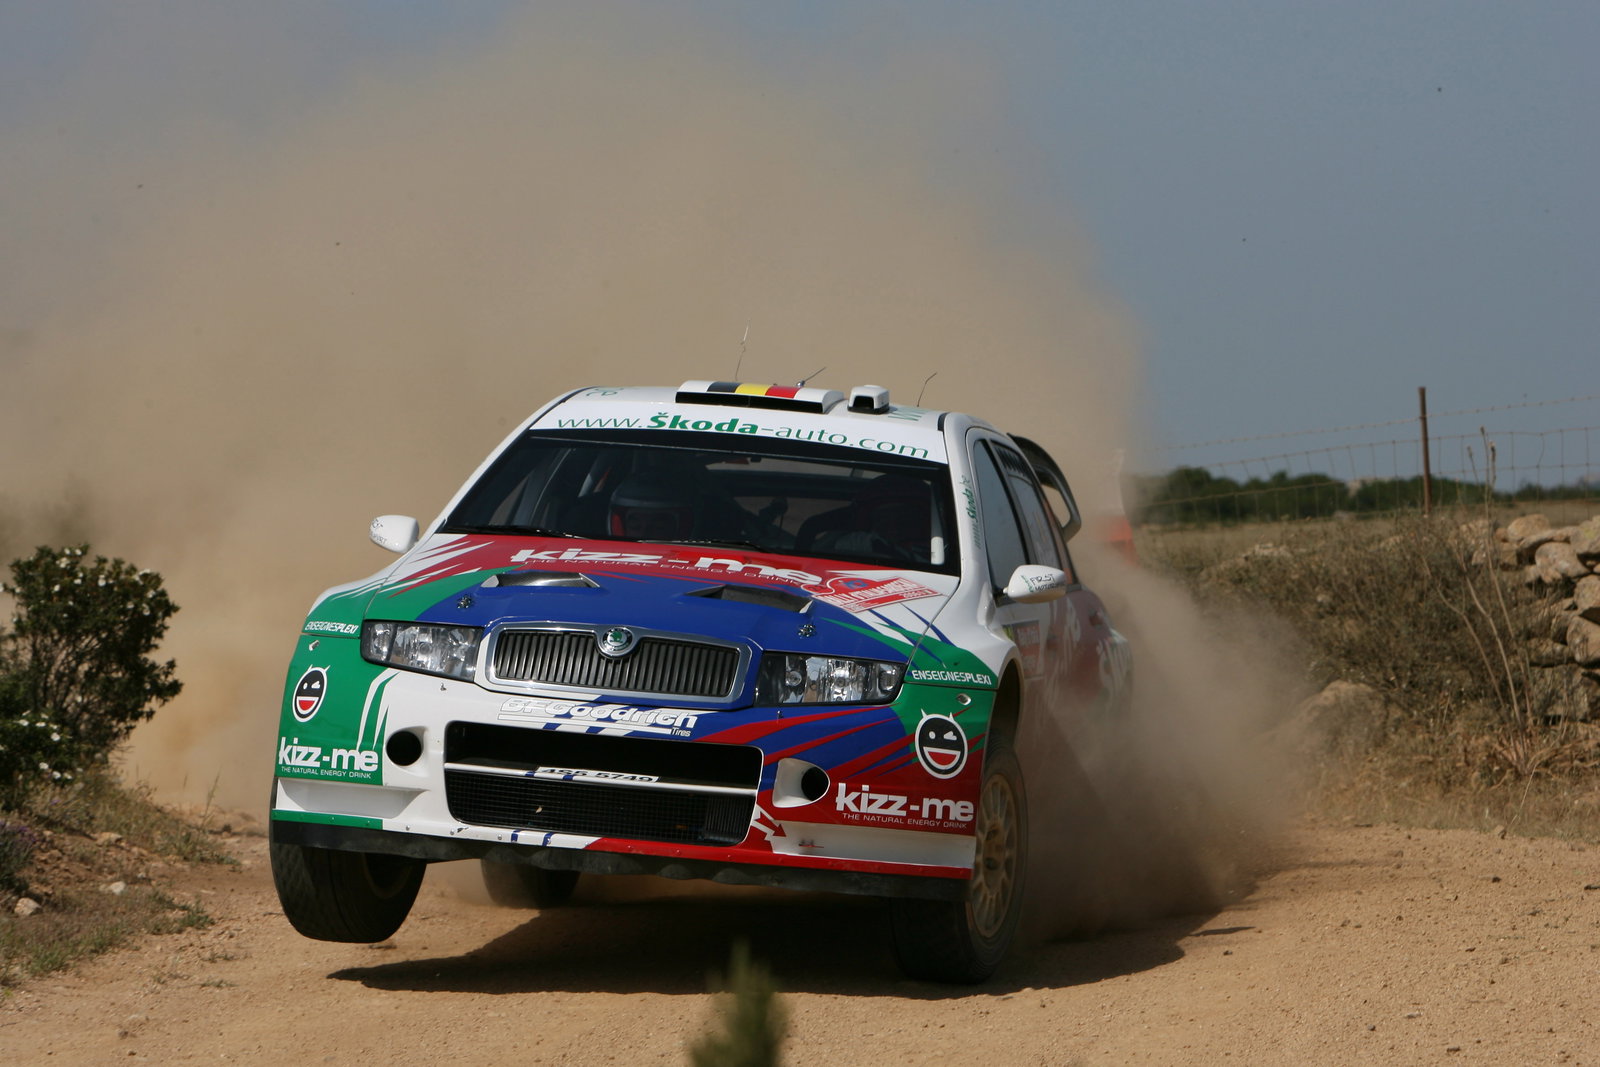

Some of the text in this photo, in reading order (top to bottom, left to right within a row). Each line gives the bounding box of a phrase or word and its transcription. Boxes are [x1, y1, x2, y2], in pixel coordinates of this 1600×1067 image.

[510, 548, 823, 585] kizz-me
[911, 669, 993, 685] ENSEIGNESPLEXI
[499, 696, 699, 729] BFGoodrich
[670, 726, 692, 737] Tires
[278, 736, 379, 772] kizz-me
[291, 767, 319, 776] NATURAL
[320, 769, 347, 777] ENERGY
[348, 771, 372, 779] DRINK
[835, 782, 975, 822] kizz-me
[842, 812, 967, 829] THE NATURAL ENERGY DRINK
